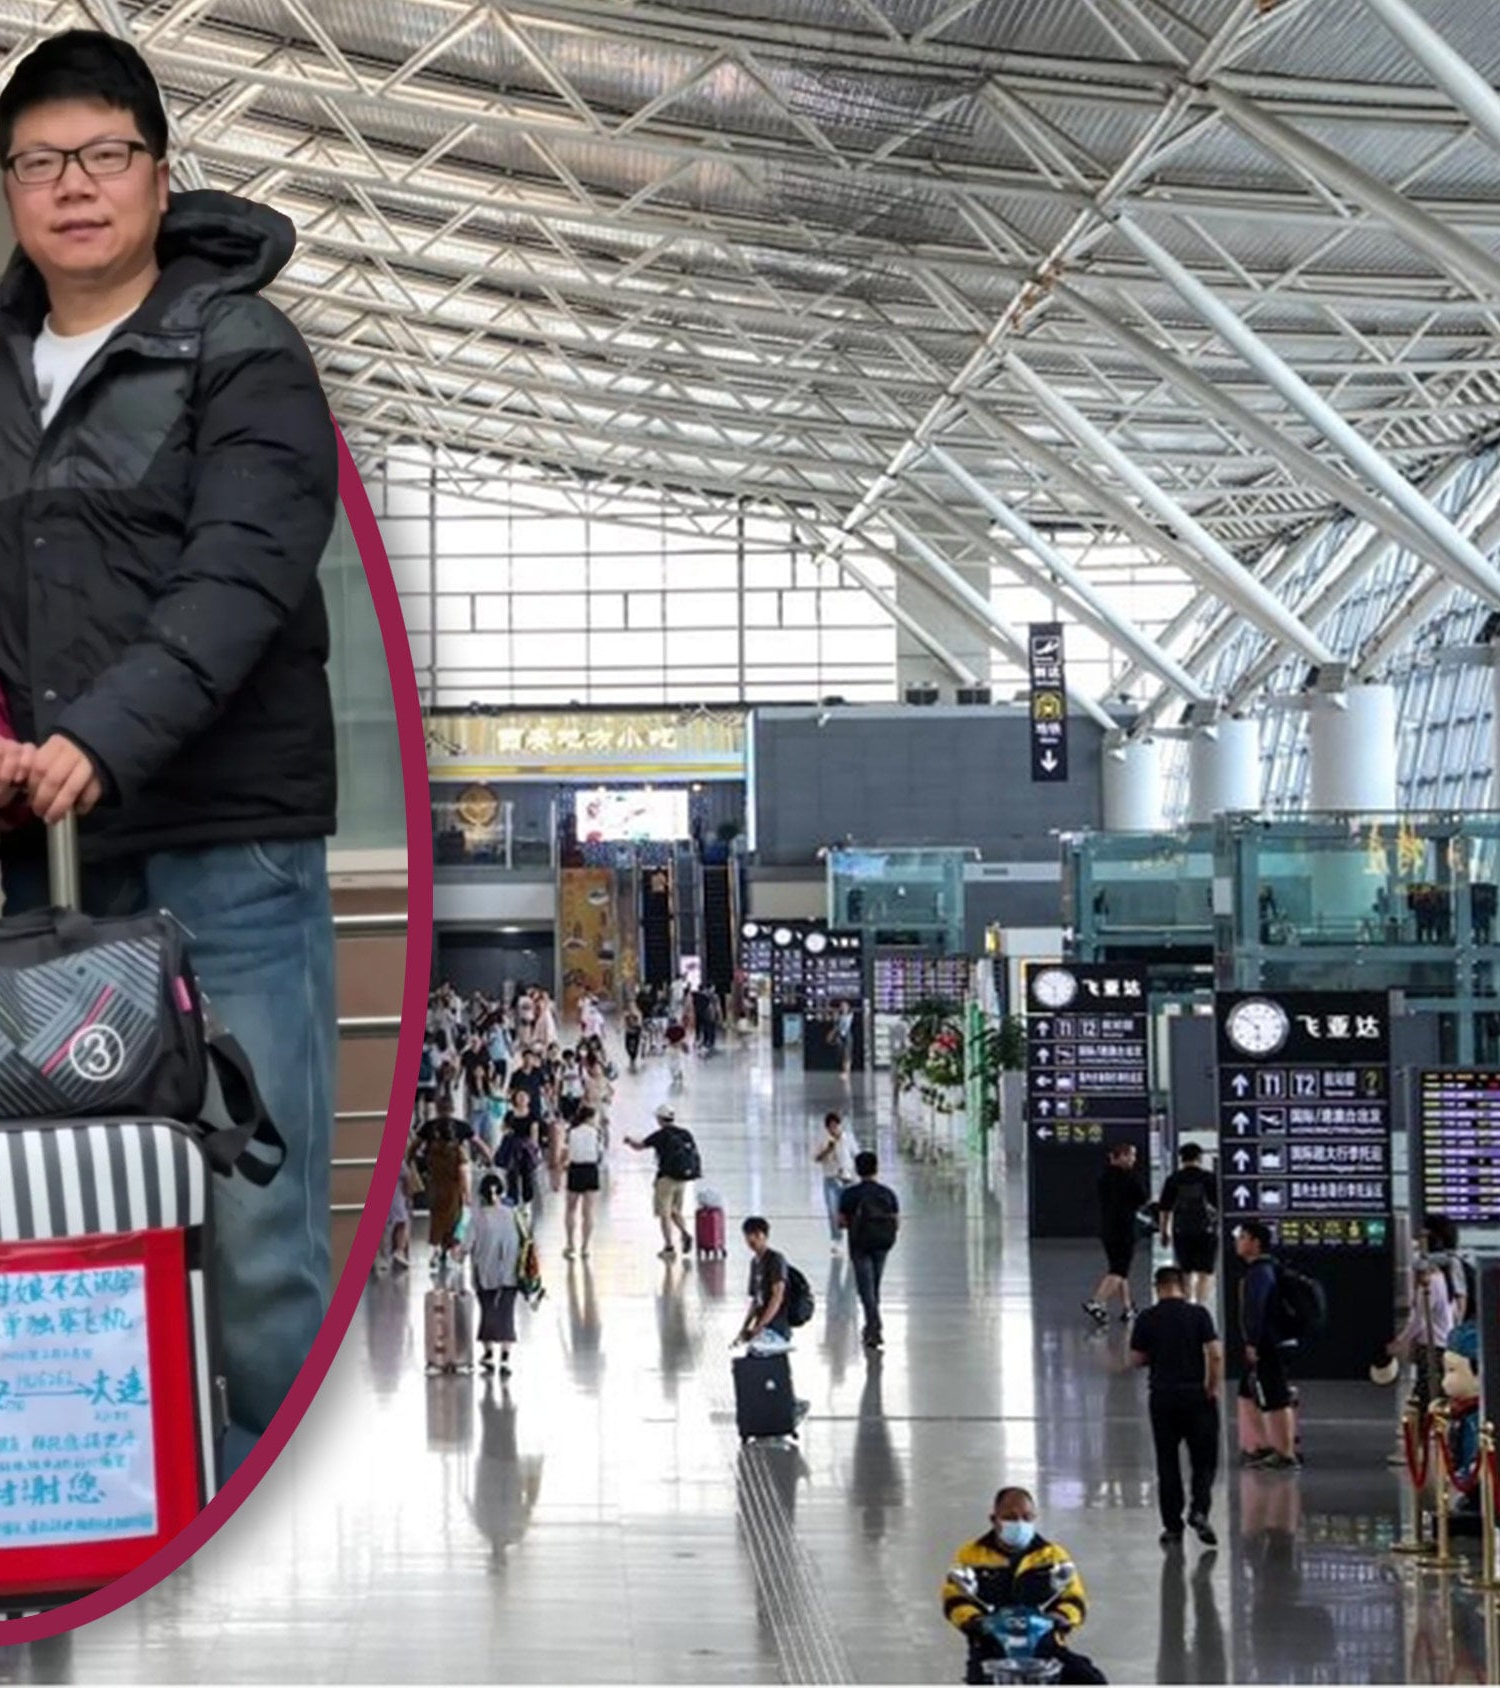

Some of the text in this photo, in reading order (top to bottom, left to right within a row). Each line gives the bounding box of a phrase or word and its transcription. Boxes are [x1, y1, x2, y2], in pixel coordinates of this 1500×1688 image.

[1296, 1014, 1380, 1038] 飞亚达
[1295, 1073, 1315, 1097] T2
[92, 1365, 149, 1406] 大连
